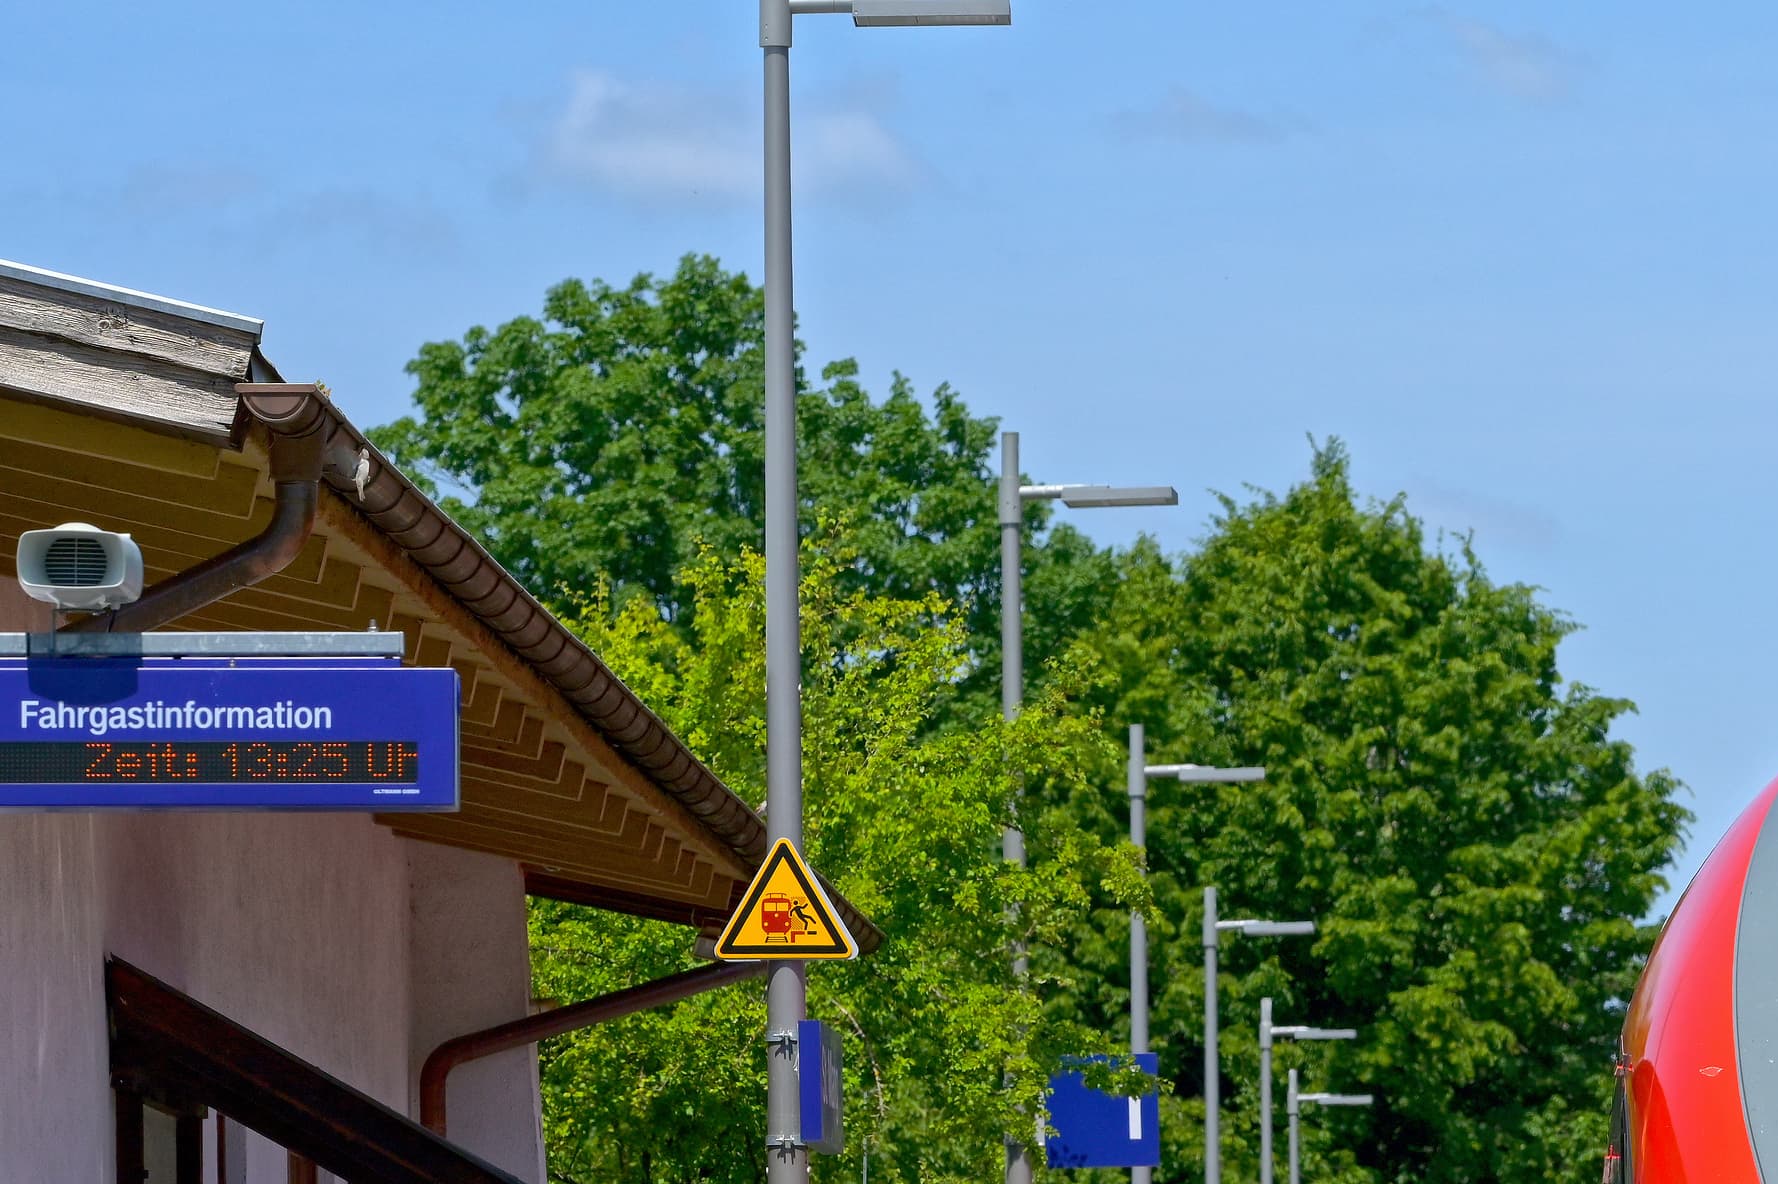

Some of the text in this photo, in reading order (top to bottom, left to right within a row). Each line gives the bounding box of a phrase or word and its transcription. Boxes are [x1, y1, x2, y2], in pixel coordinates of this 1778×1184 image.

[19, 700, 332, 734] Fahrgastinformation
[85, 743, 199, 778] Zeit:
[222, 743, 348, 778] 13:25
